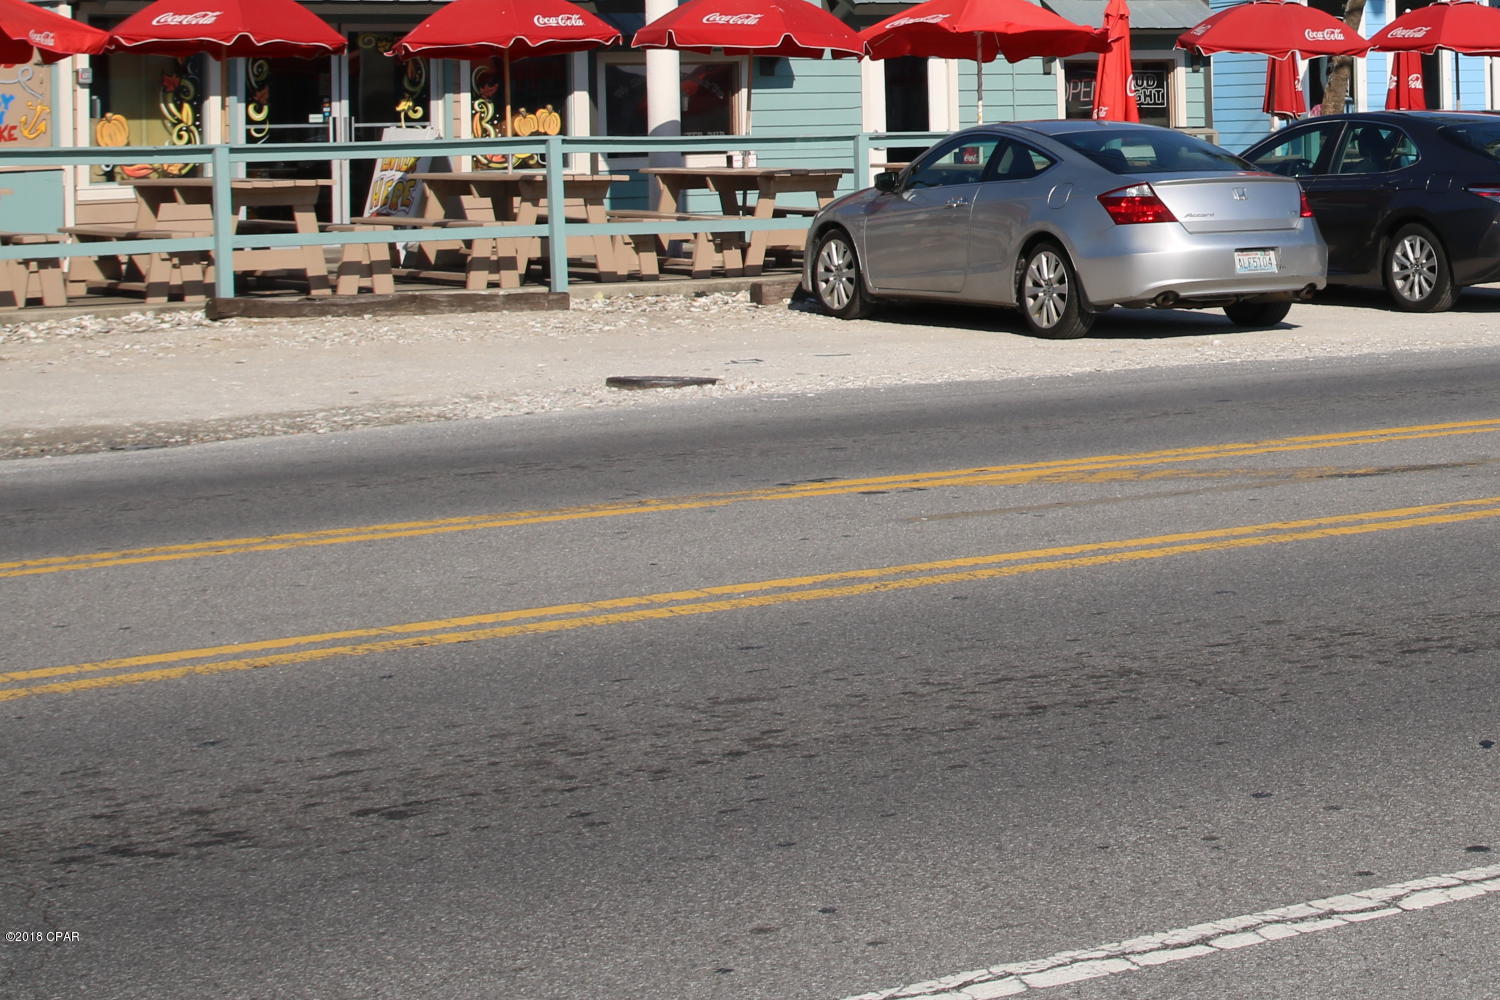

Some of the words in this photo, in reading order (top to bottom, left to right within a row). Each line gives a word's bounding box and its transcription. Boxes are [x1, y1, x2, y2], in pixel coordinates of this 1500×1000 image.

[151, 11, 224, 26] Coca-Cola
[533, 14, 585, 27] Coca-Cola
[702, 12, 764, 25] Coca-Cola
[1304, 28, 1345, 41] Coca-Cola
[1132, 74, 1157, 89] UD
[1136, 88, 1164, 104] GHT
